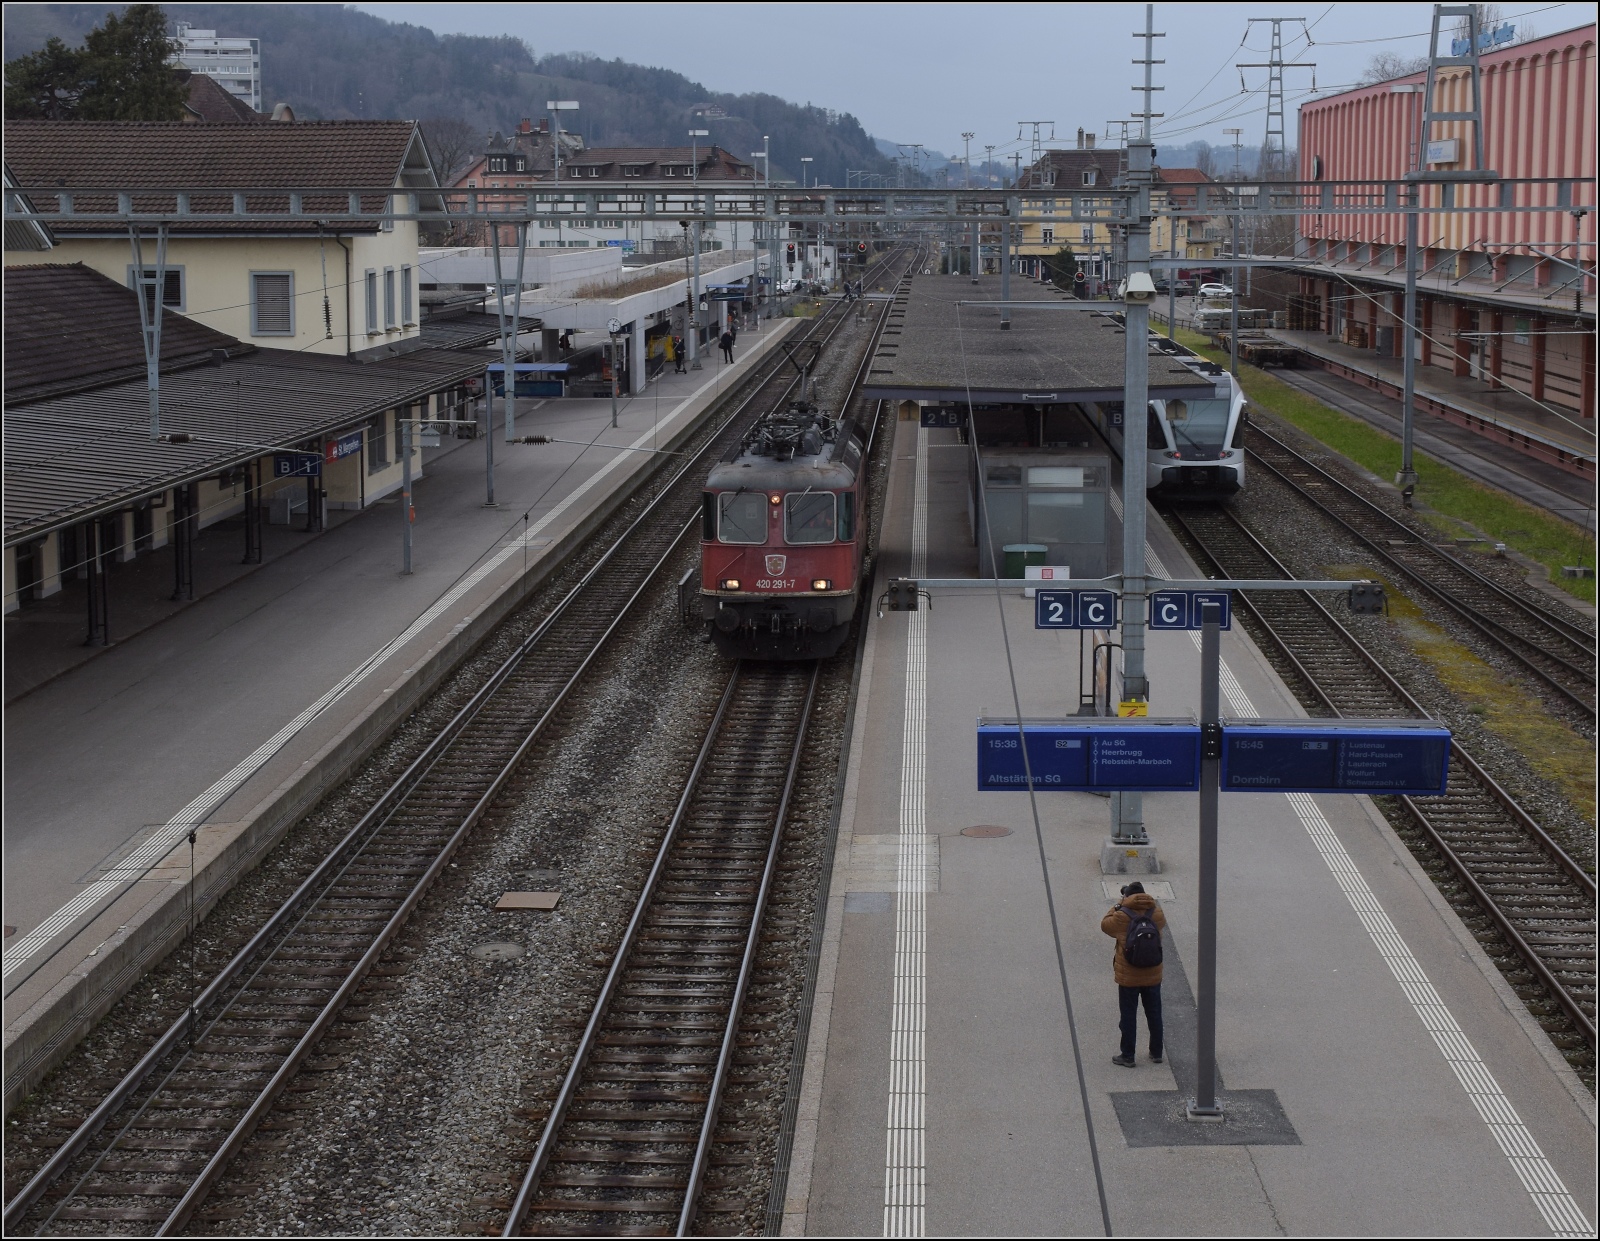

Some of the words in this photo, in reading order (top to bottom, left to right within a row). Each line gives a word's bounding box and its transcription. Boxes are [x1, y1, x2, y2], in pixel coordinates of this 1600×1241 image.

[927, 412, 937, 424] 2
[948, 412, 958, 424] B
[1113, 413, 1123, 424] B
[280, 461, 290, 473] B
[304, 460, 311, 473] 1
[755, 579, 771, 589] 420
[772, 579, 796, 589] 291-7
[1048, 602, 1064, 622] 2
[1088, 602, 1105, 623] C
[1161, 603, 1178, 623] C
[988, 739, 1018, 749] 15:38
[1056, 739, 1068, 748] S2
[1101, 739, 1113, 747] Au
[1114, 739, 1126, 747] SG
[1234, 740, 1264, 750] 15:45
[1349, 741, 1386, 749] Lustenau
[1101, 748, 1143, 757] Heerbrugg
[1348, 751, 1403, 759] Hard-Fussach
[1101, 757, 1172, 766] Rebstein-Marbach
[1347, 760, 1387, 768] Lauterach
[1347, 769, 1376, 778] Wolfurt
[1045, 774, 1061, 783] SG
[1232, 775, 1281, 785] Dornbirn
[1346, 778, 1394, 786] Schwarzach
